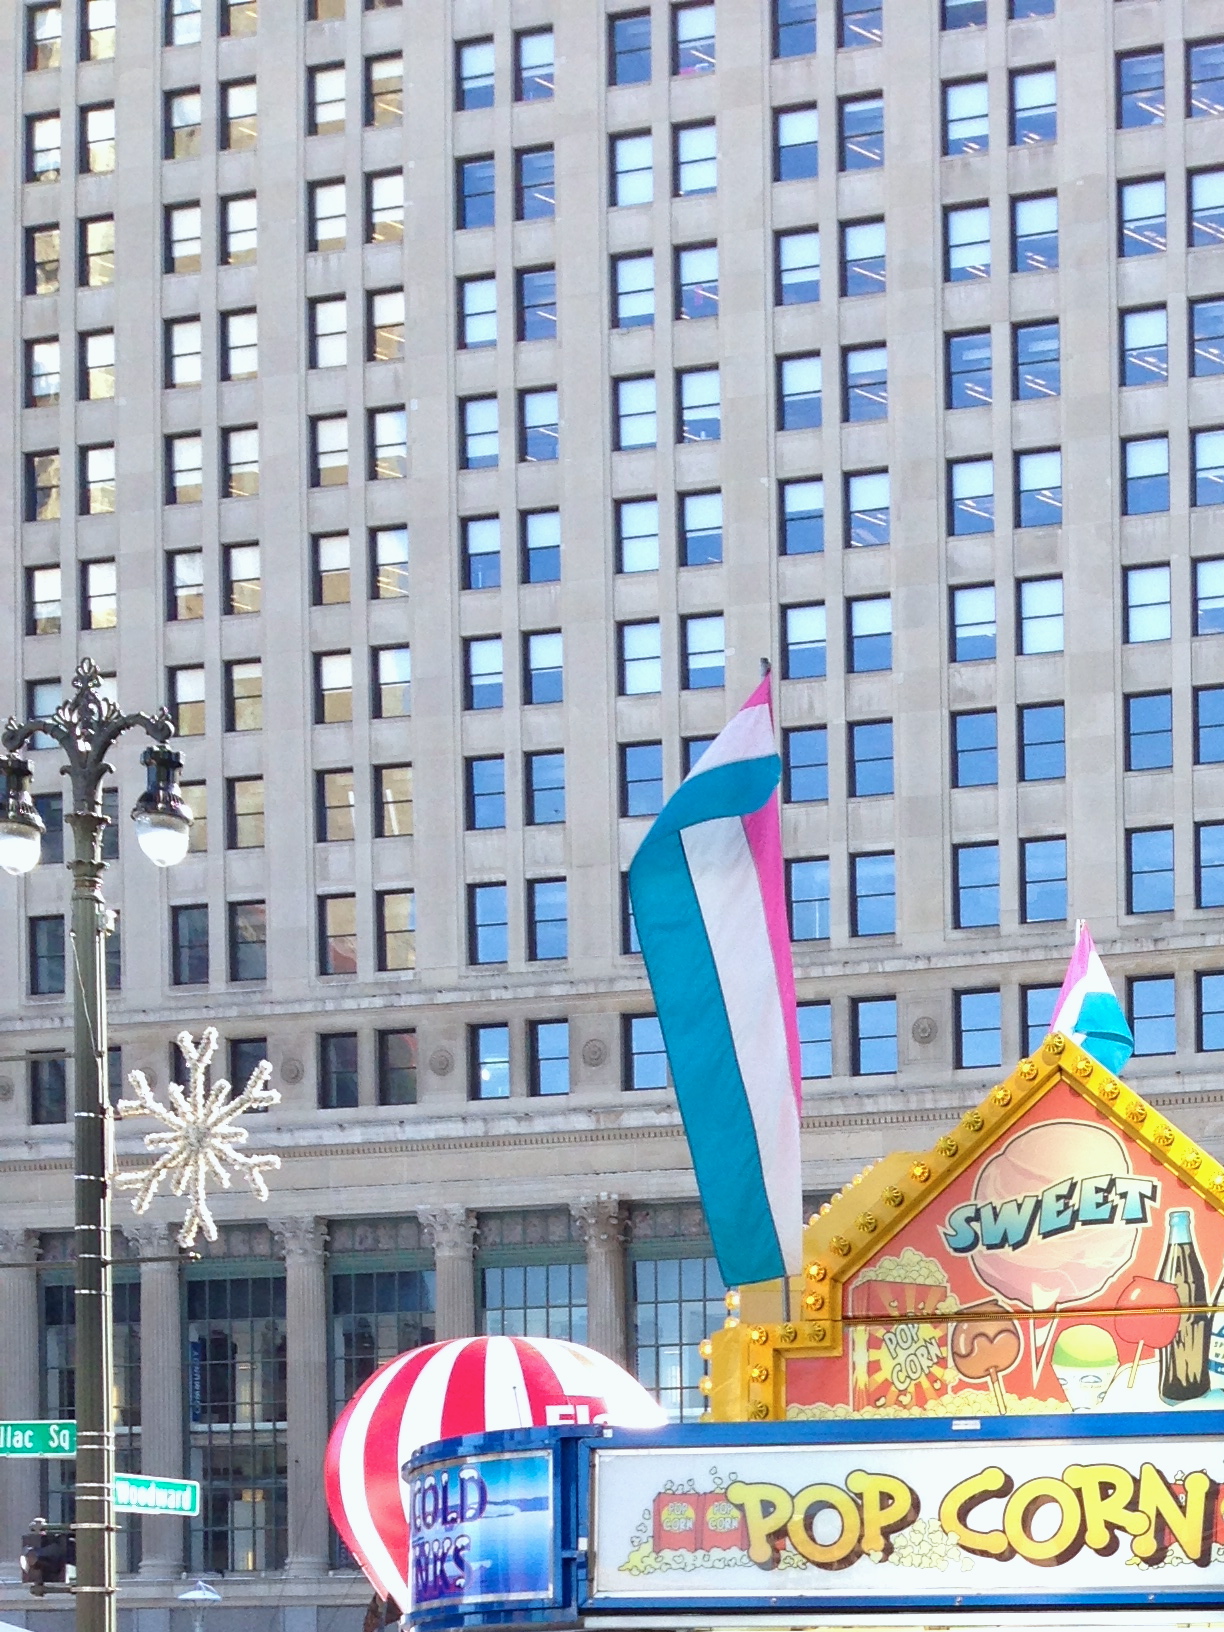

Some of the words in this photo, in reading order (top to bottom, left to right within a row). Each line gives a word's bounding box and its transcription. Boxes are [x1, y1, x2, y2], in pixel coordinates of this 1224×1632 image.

[946, 1175, 1157, 1252] SWEET
[891, 1336, 943, 1391] CORN
[49, 1425, 70, 1450] Sq
[115, 1480, 191, 1511] Woodward
[413, 1465, 487, 1532] COLD
[669, 1502, 688, 1515] POP
[713, 1502, 733, 1515] POP
[662, 1517, 694, 1531] CORN
[726, 1468, 920, 1569] POP
[940, 1462, 1219, 1568] CORN
